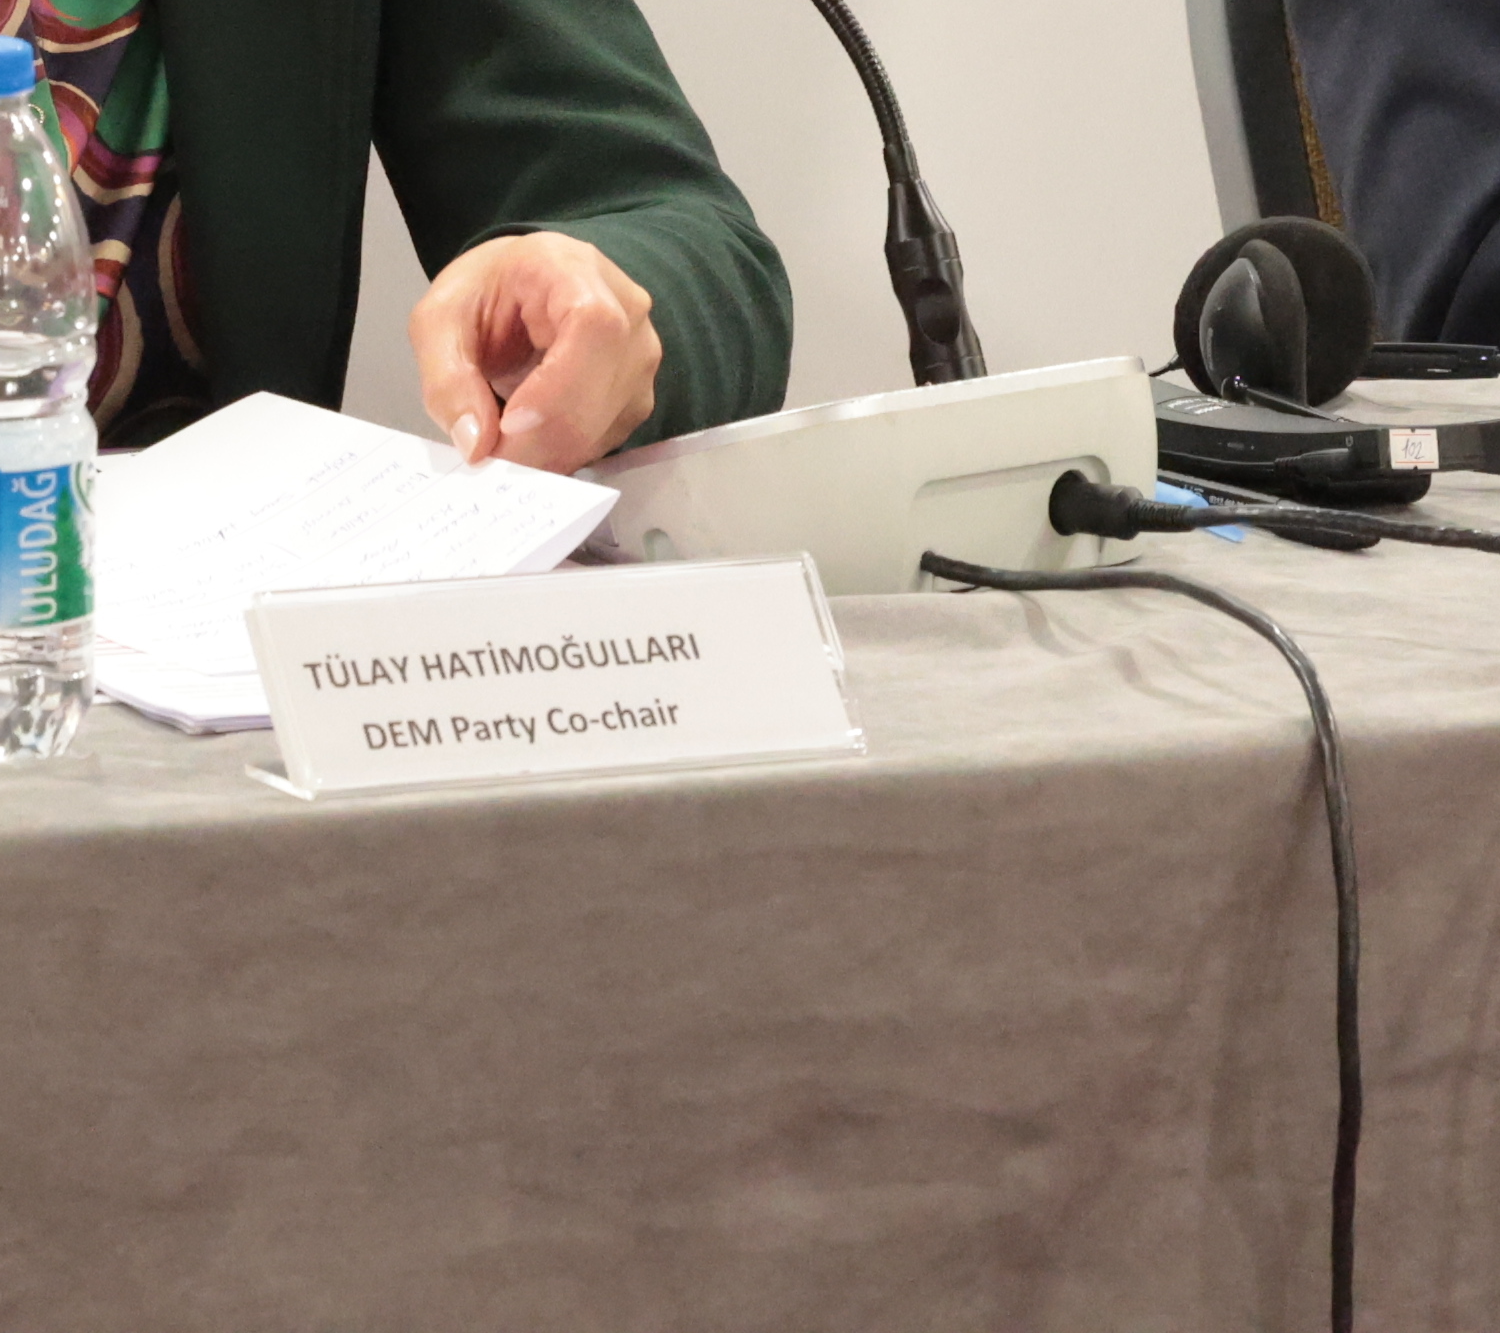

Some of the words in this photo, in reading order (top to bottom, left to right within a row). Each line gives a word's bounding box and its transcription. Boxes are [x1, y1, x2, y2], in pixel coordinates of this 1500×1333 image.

[11, 471, 58, 623] ULUDAĞ
[303, 654, 409, 690] TÜLAY
[421, 633, 701, 681] HATİMOĞULLARI
[362, 718, 443, 750] DEM
[451, 712, 538, 744] Party
[547, 697, 679, 734] Co-chair
